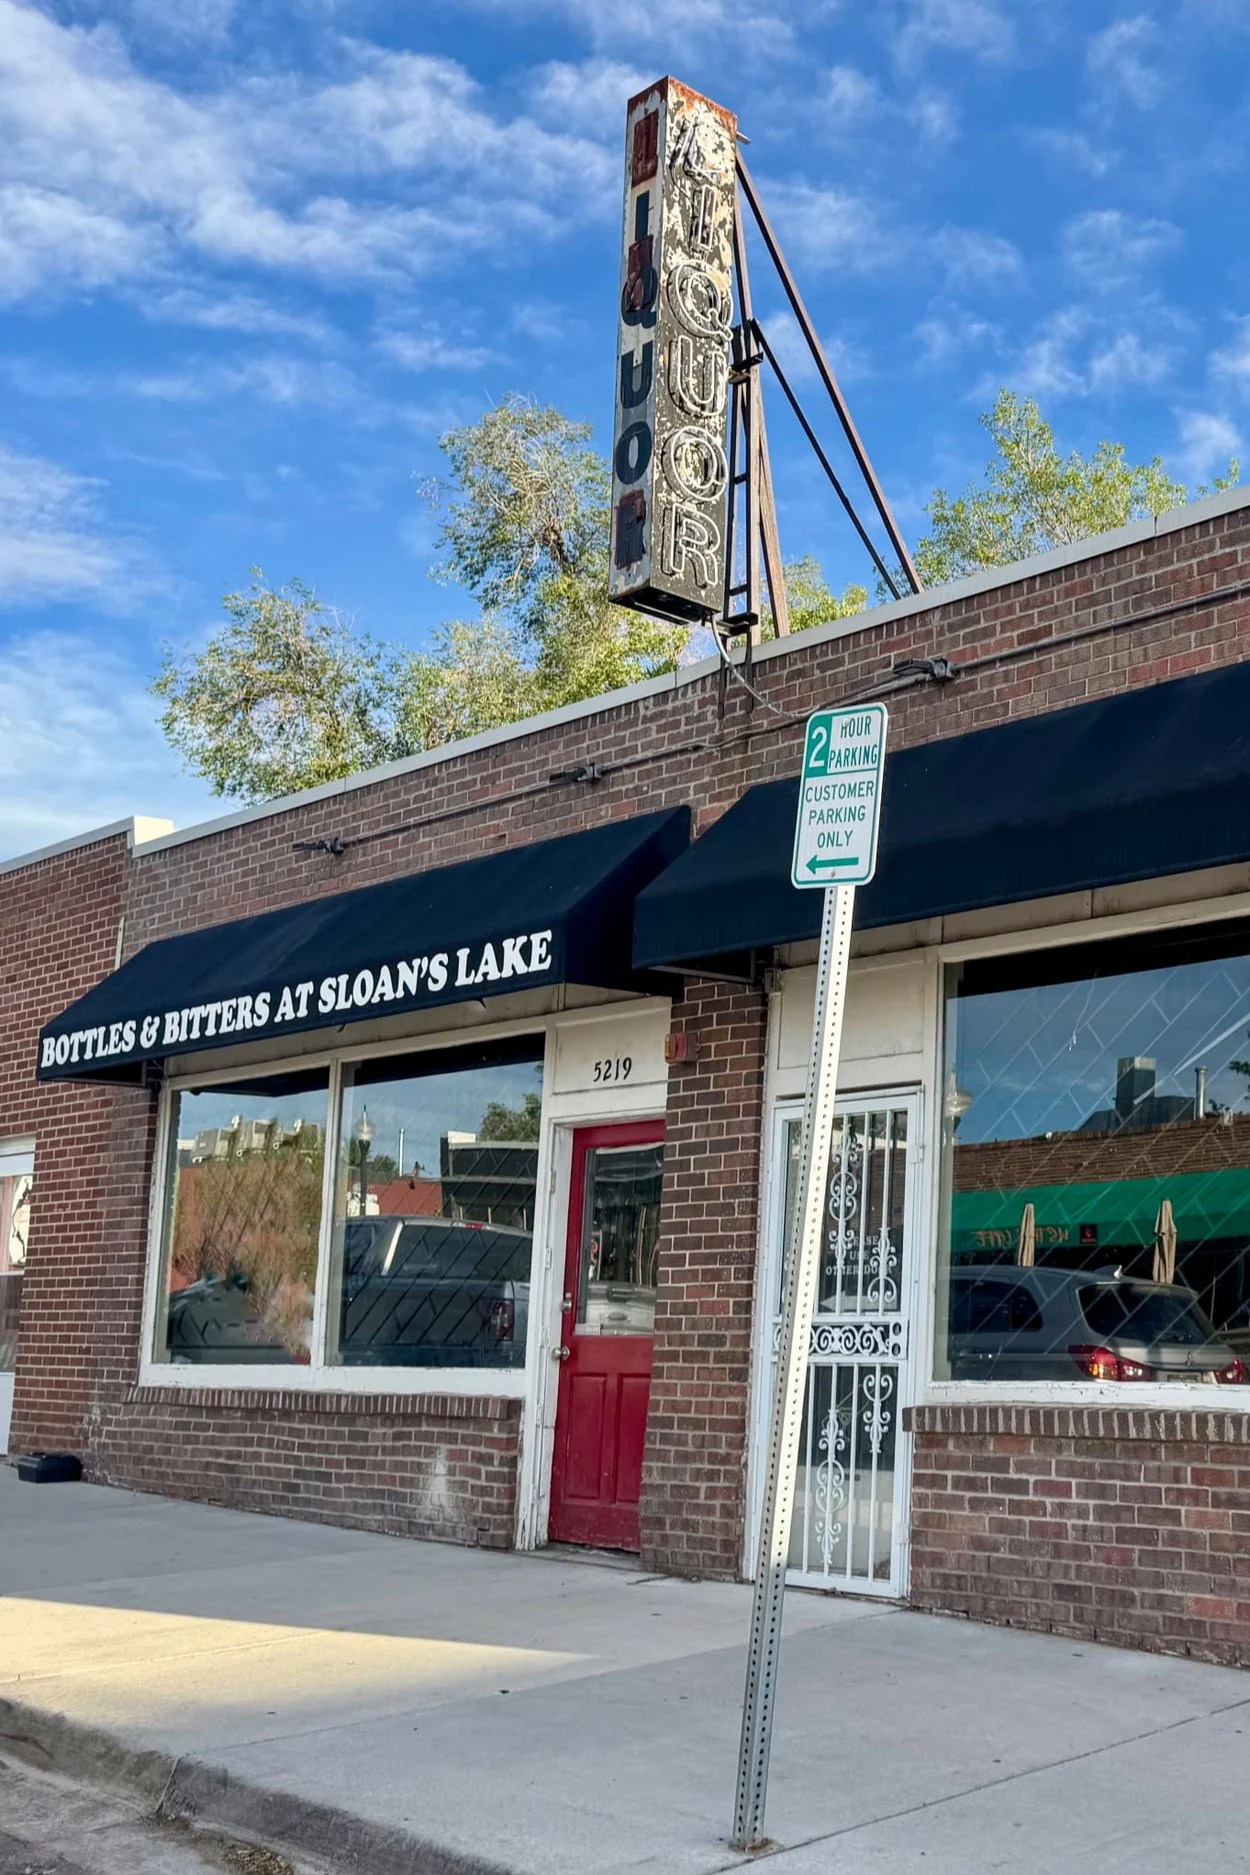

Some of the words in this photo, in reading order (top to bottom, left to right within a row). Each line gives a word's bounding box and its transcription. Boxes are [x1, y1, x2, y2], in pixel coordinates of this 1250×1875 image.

[614, 108, 660, 571] IQUOR
[661, 118, 734, 588] LIQUOR
[808, 726, 828, 769] 2
[840, 715, 872, 739] HOUR
[828, 743, 878, 769] PARKING
[805, 780, 875, 803] CUSTOMER
[808, 805, 866, 826] PARKING
[817, 830, 854, 849] ONLY
[40, 1020, 137, 1068] BOTTLES
[139, 1015, 160, 1049] &
[163, 992, 271, 1045] BITTERS
[273, 981, 314, 1023] AT
[318, 953, 449, 1013] SLOAN'S
[455, 930, 552, 987] LAKE
[593, 1056, 633, 1084] 5219
[849, 1250, 870, 1260] UE
